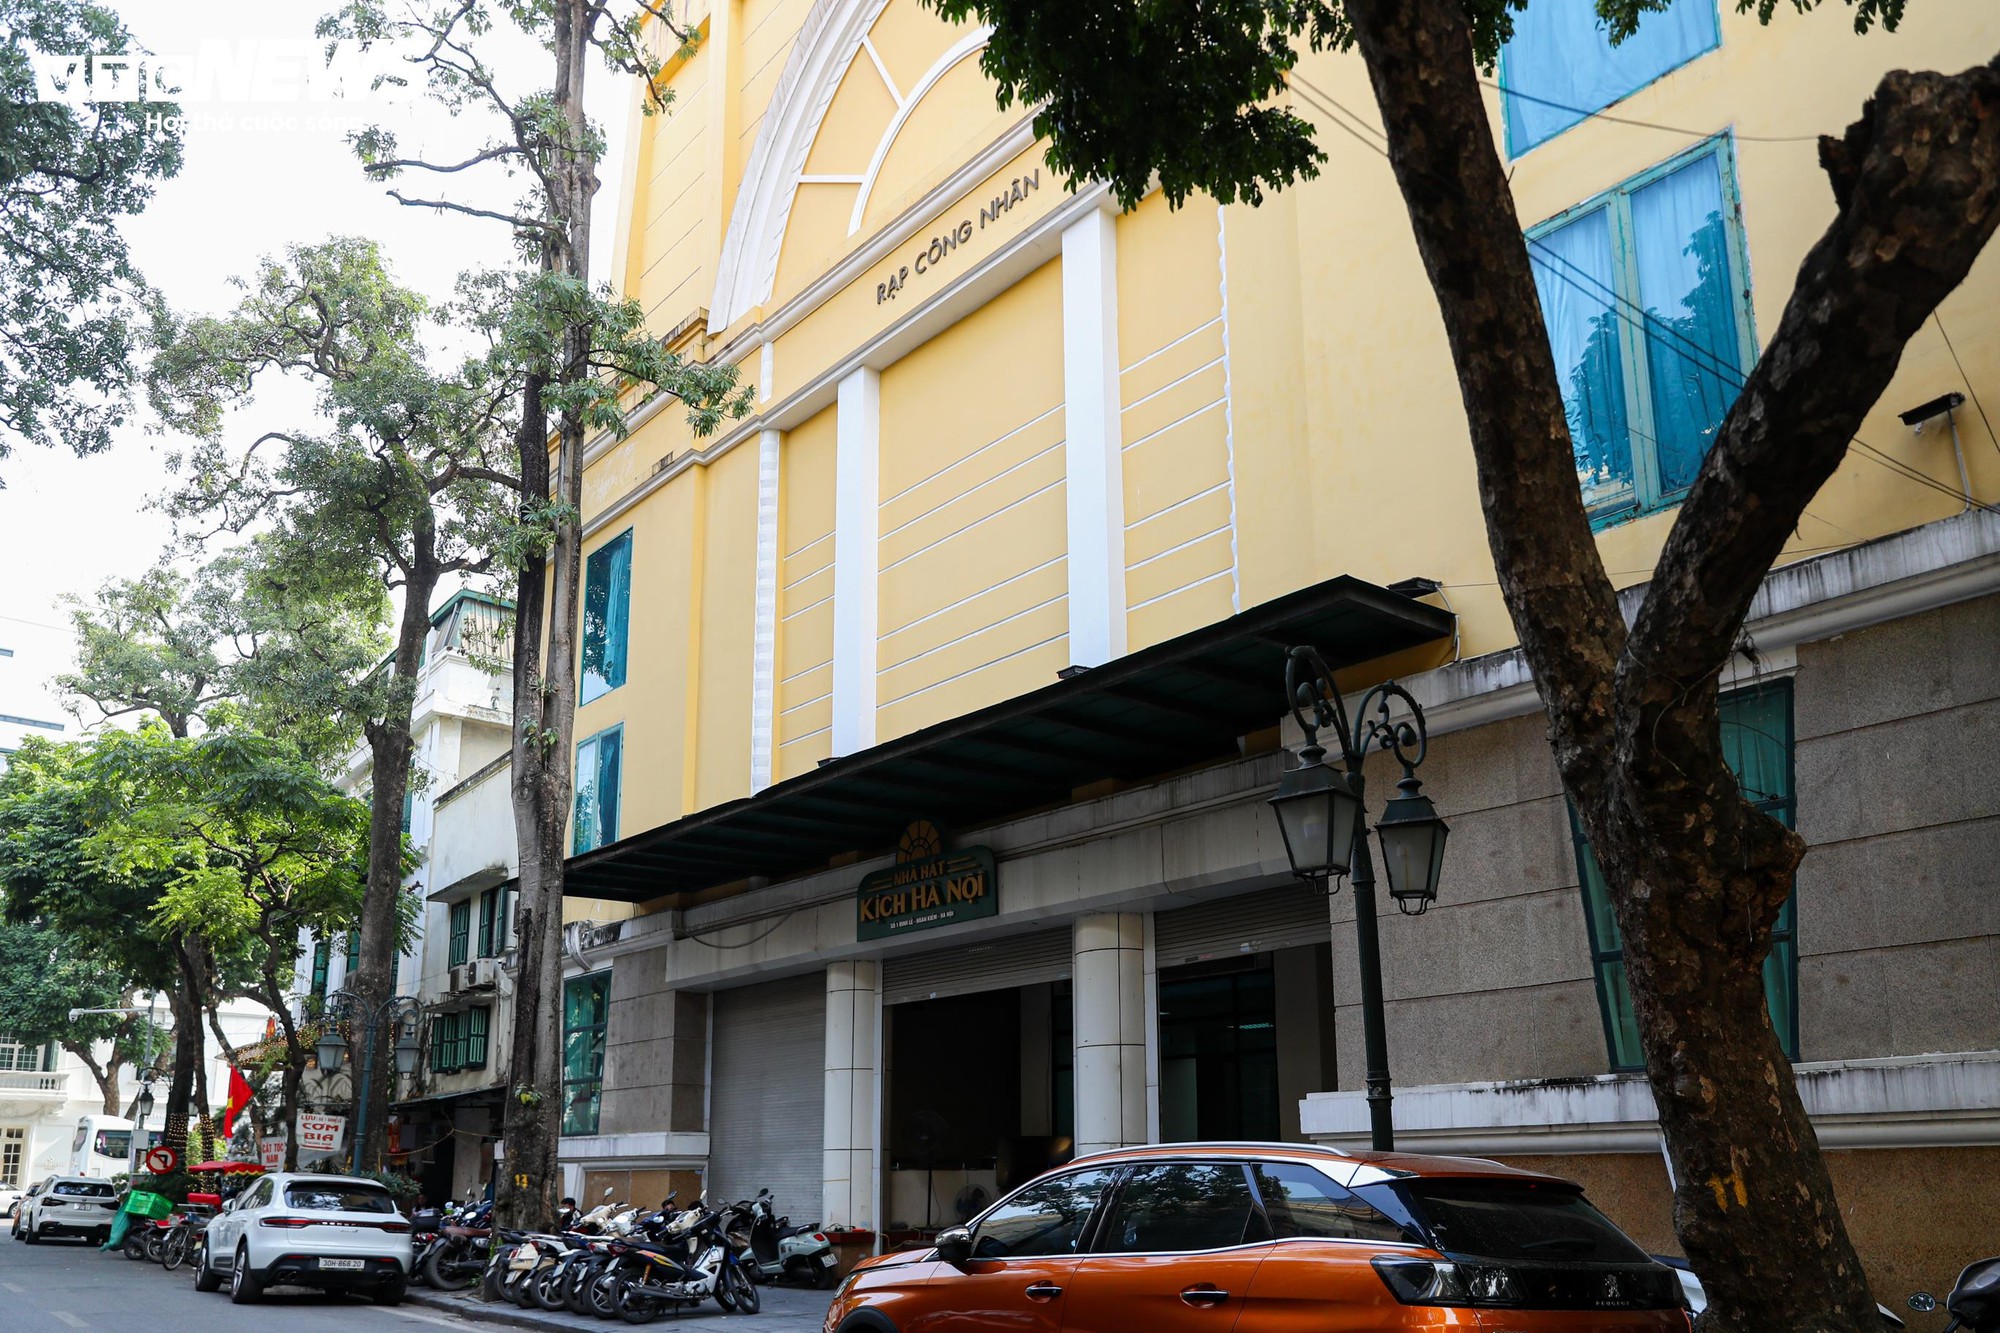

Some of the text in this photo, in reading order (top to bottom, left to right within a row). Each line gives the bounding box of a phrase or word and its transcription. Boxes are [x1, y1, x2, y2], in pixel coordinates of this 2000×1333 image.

[876, 168, 1040, 304] RẠP CÔNG NHÂN
[894, 859, 946, 886] NHÀ HÁT
[860, 870, 985, 924] KỊCH HÀ NỘI
[302, 1122, 339, 1132] CƠM
[304, 1132, 334, 1141] BIA
[266, 1154, 279, 1163] NAM
